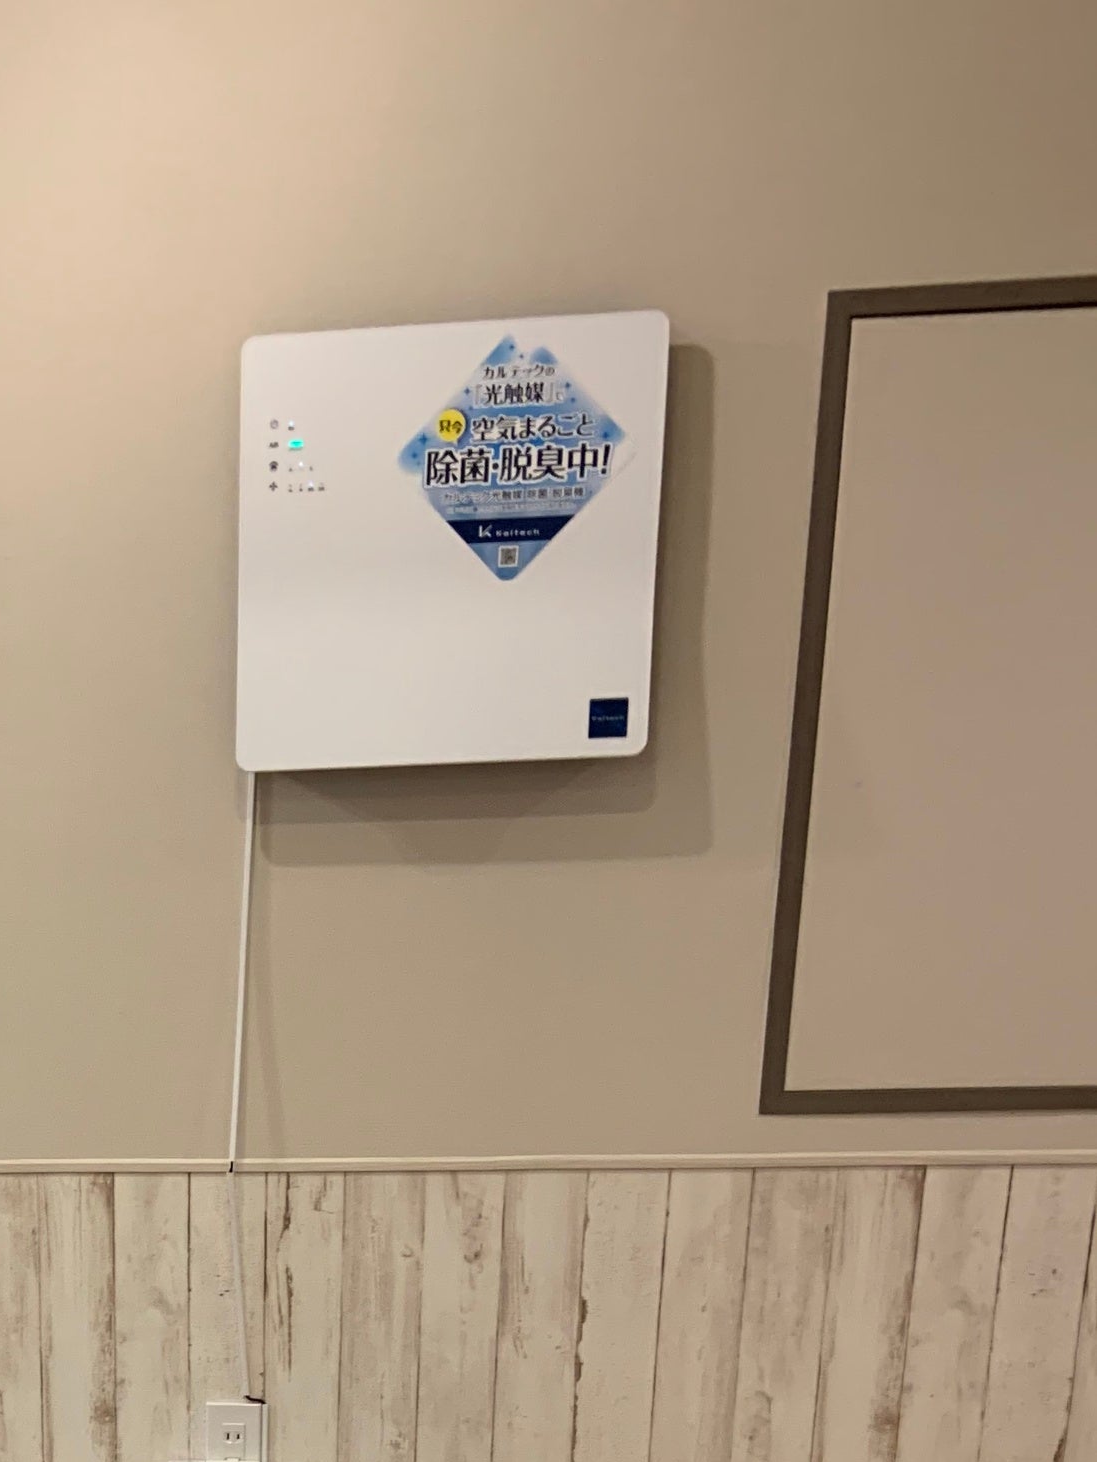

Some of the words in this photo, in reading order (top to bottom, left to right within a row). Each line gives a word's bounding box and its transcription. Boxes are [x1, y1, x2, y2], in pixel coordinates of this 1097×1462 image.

[483, 364, 556, 379] カルテックの
[439, 418, 462, 434] 只今
[472, 413, 595, 442] 空気まるごと
